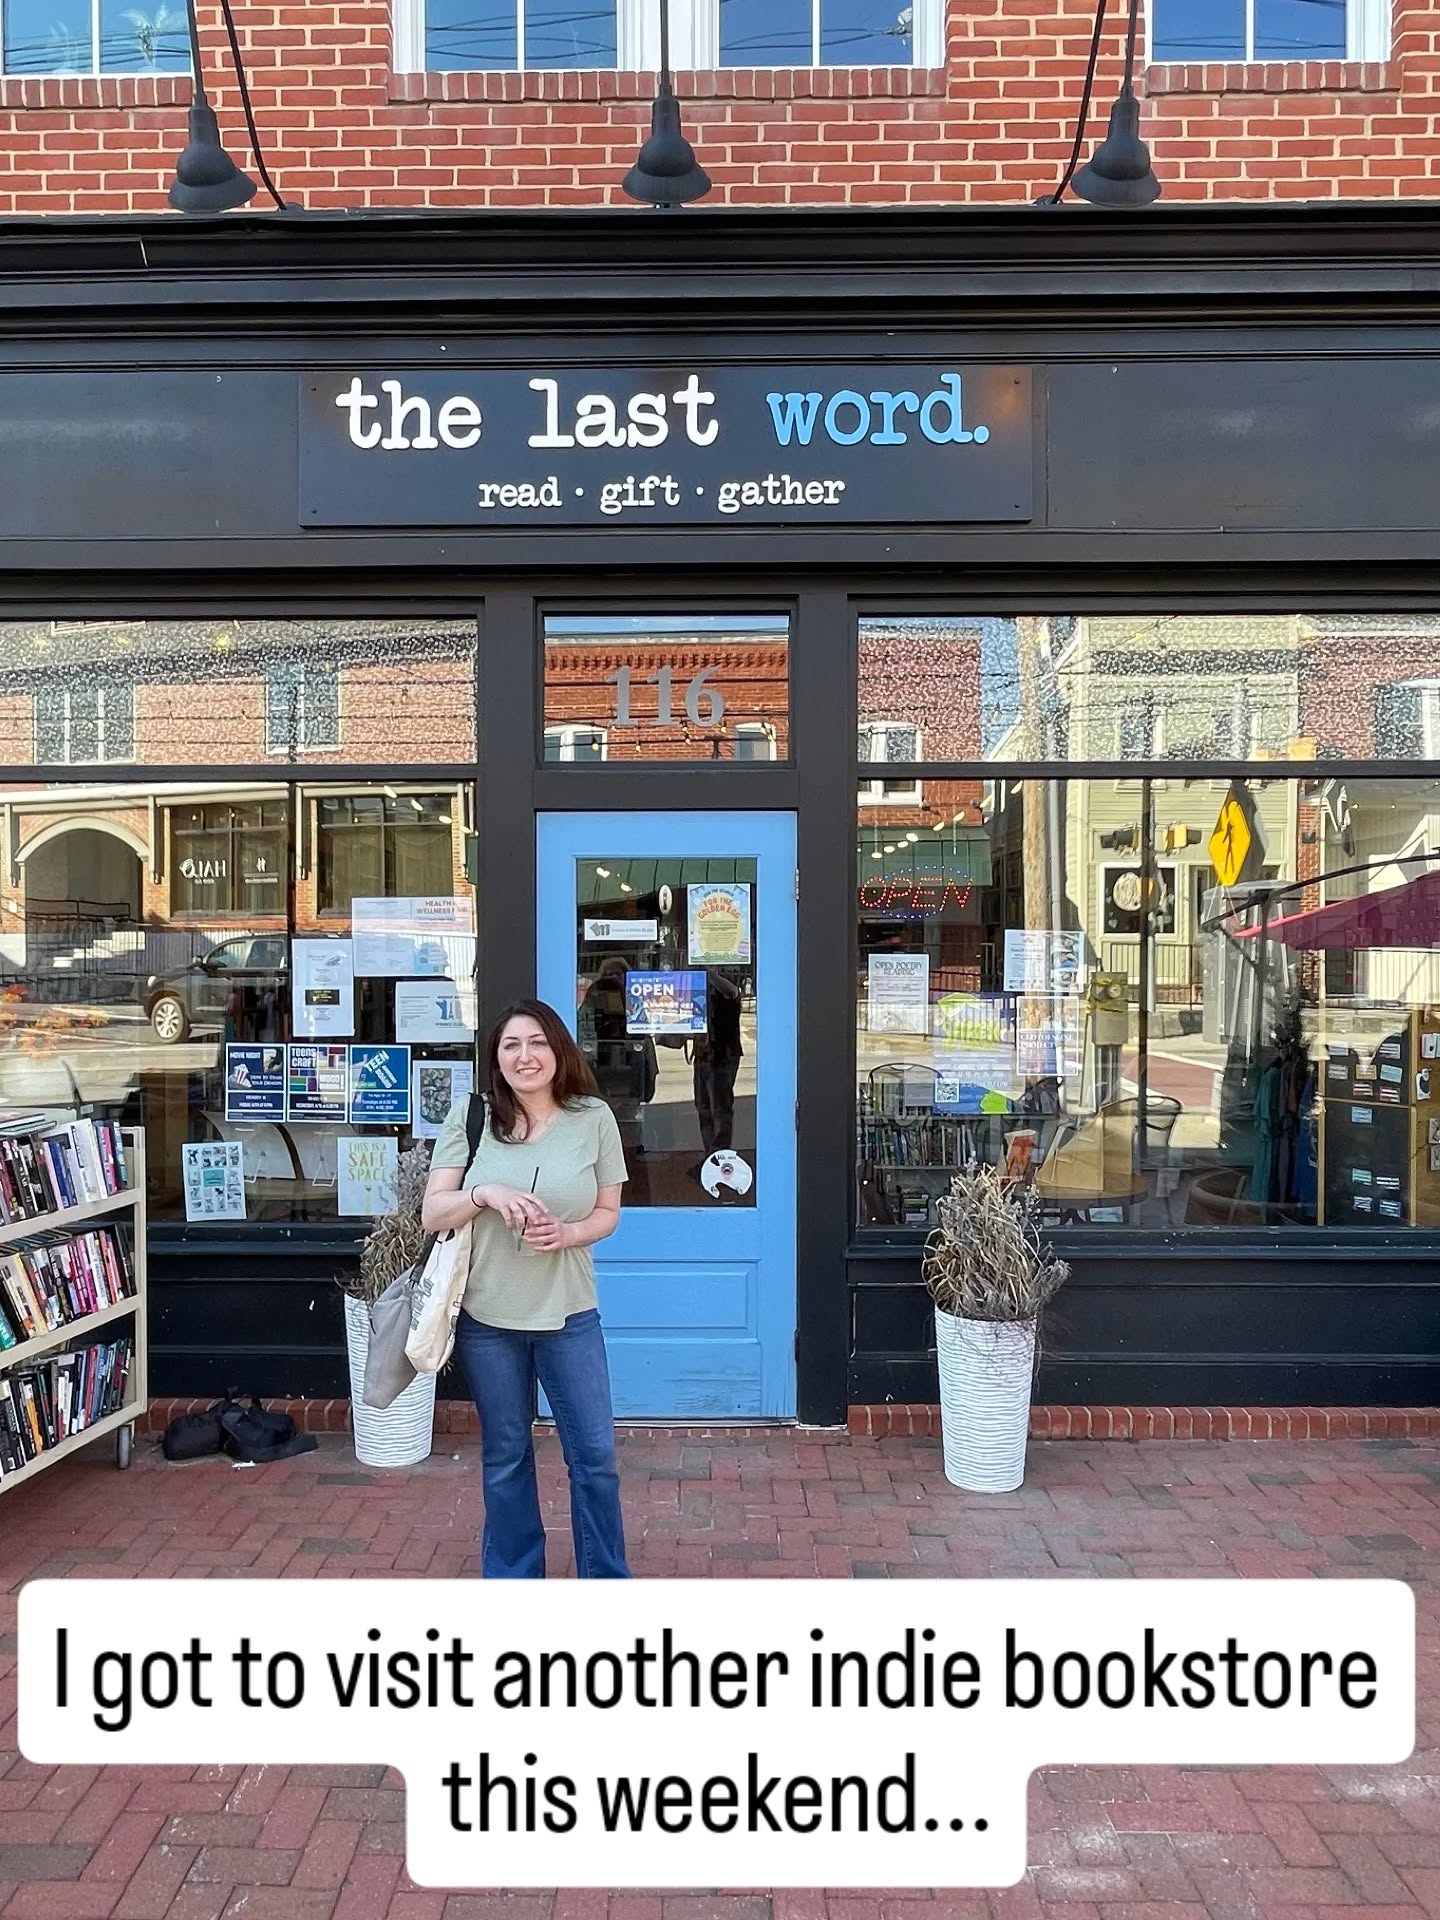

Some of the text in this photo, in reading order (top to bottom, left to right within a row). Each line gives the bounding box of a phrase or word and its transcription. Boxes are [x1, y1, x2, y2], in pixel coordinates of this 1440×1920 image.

[335, 373, 990, 450] the last word.
[478, 473, 846, 515] read gift gather
[606, 663, 725, 727] 116
[861, 875, 973, 909] OPEN
[703, 896, 734, 908] FOR THE
[416, 907, 451, 915] WELLNESS
[698, 903, 741, 920] GOLDEN EGG
[630, 983, 674, 997] OPEN
[364, 1049, 390, 1073] TEEN
[348, 1142, 369, 1153] THIS
[371, 1142, 380, 1151] IS
[348, 1152, 388, 1168] SAFE
[348, 1167, 388, 1182] SPACE
